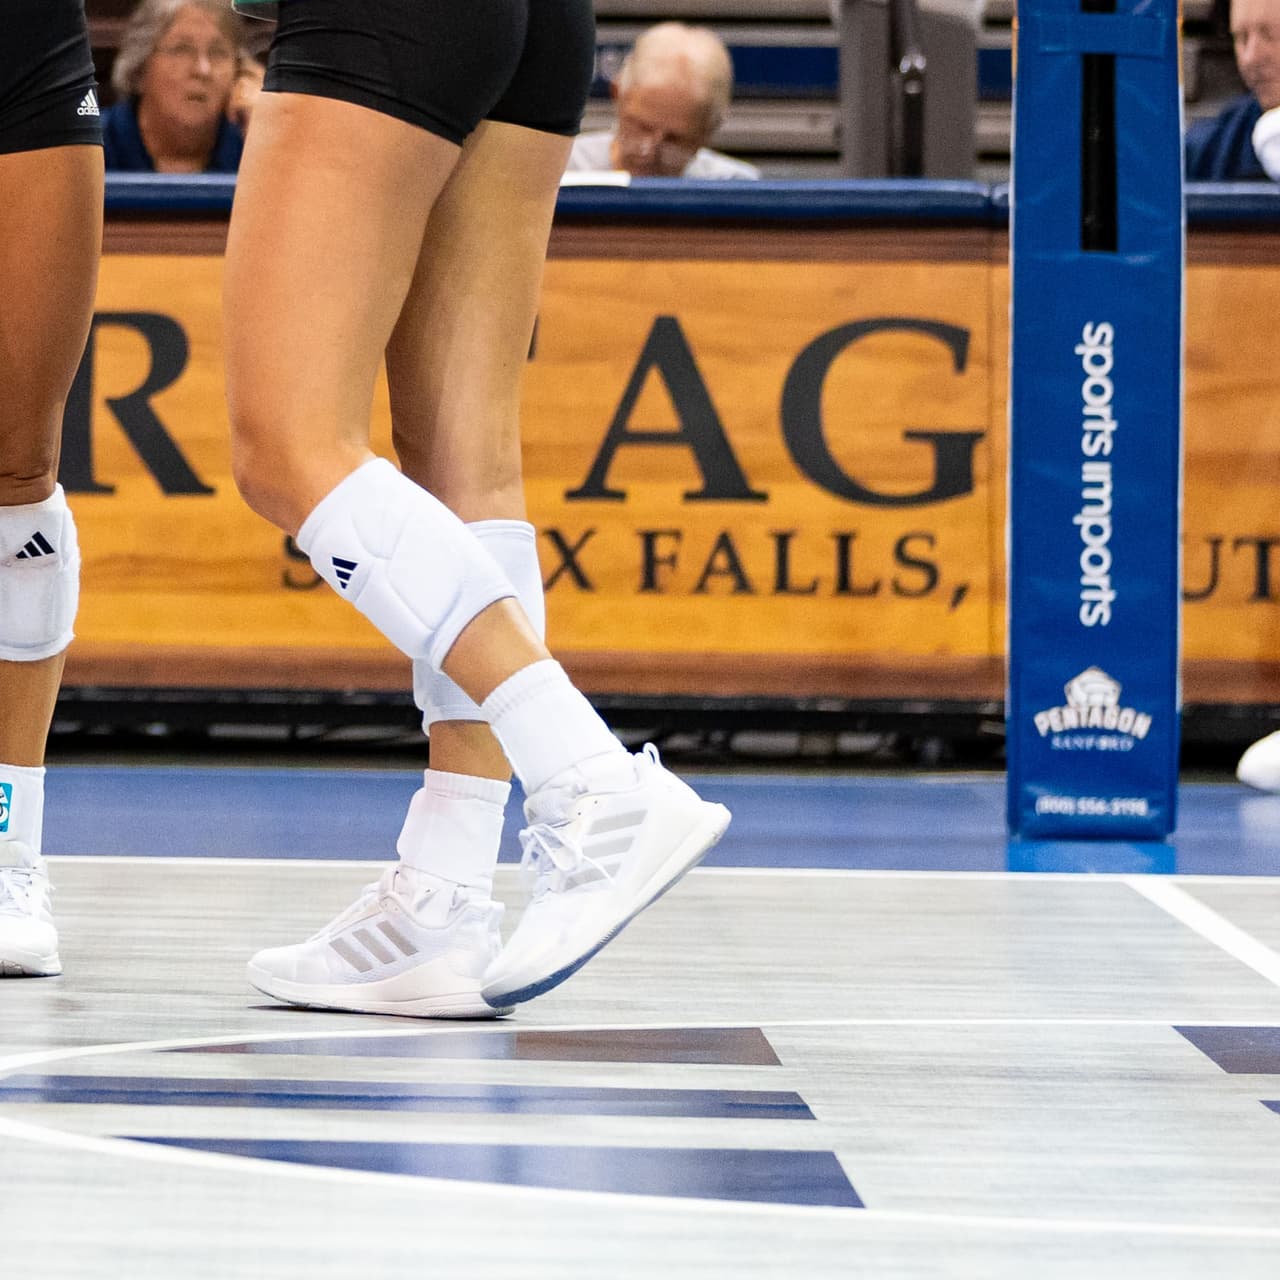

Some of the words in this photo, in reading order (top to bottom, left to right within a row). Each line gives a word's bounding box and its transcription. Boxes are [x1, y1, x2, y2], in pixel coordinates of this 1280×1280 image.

[1073, 321, 1118, 457] sports
[635, 527, 969, 610] FALLS,
[1072, 461, 1116, 627] imports
[1033, 704, 1153, 740] PENTAGON
